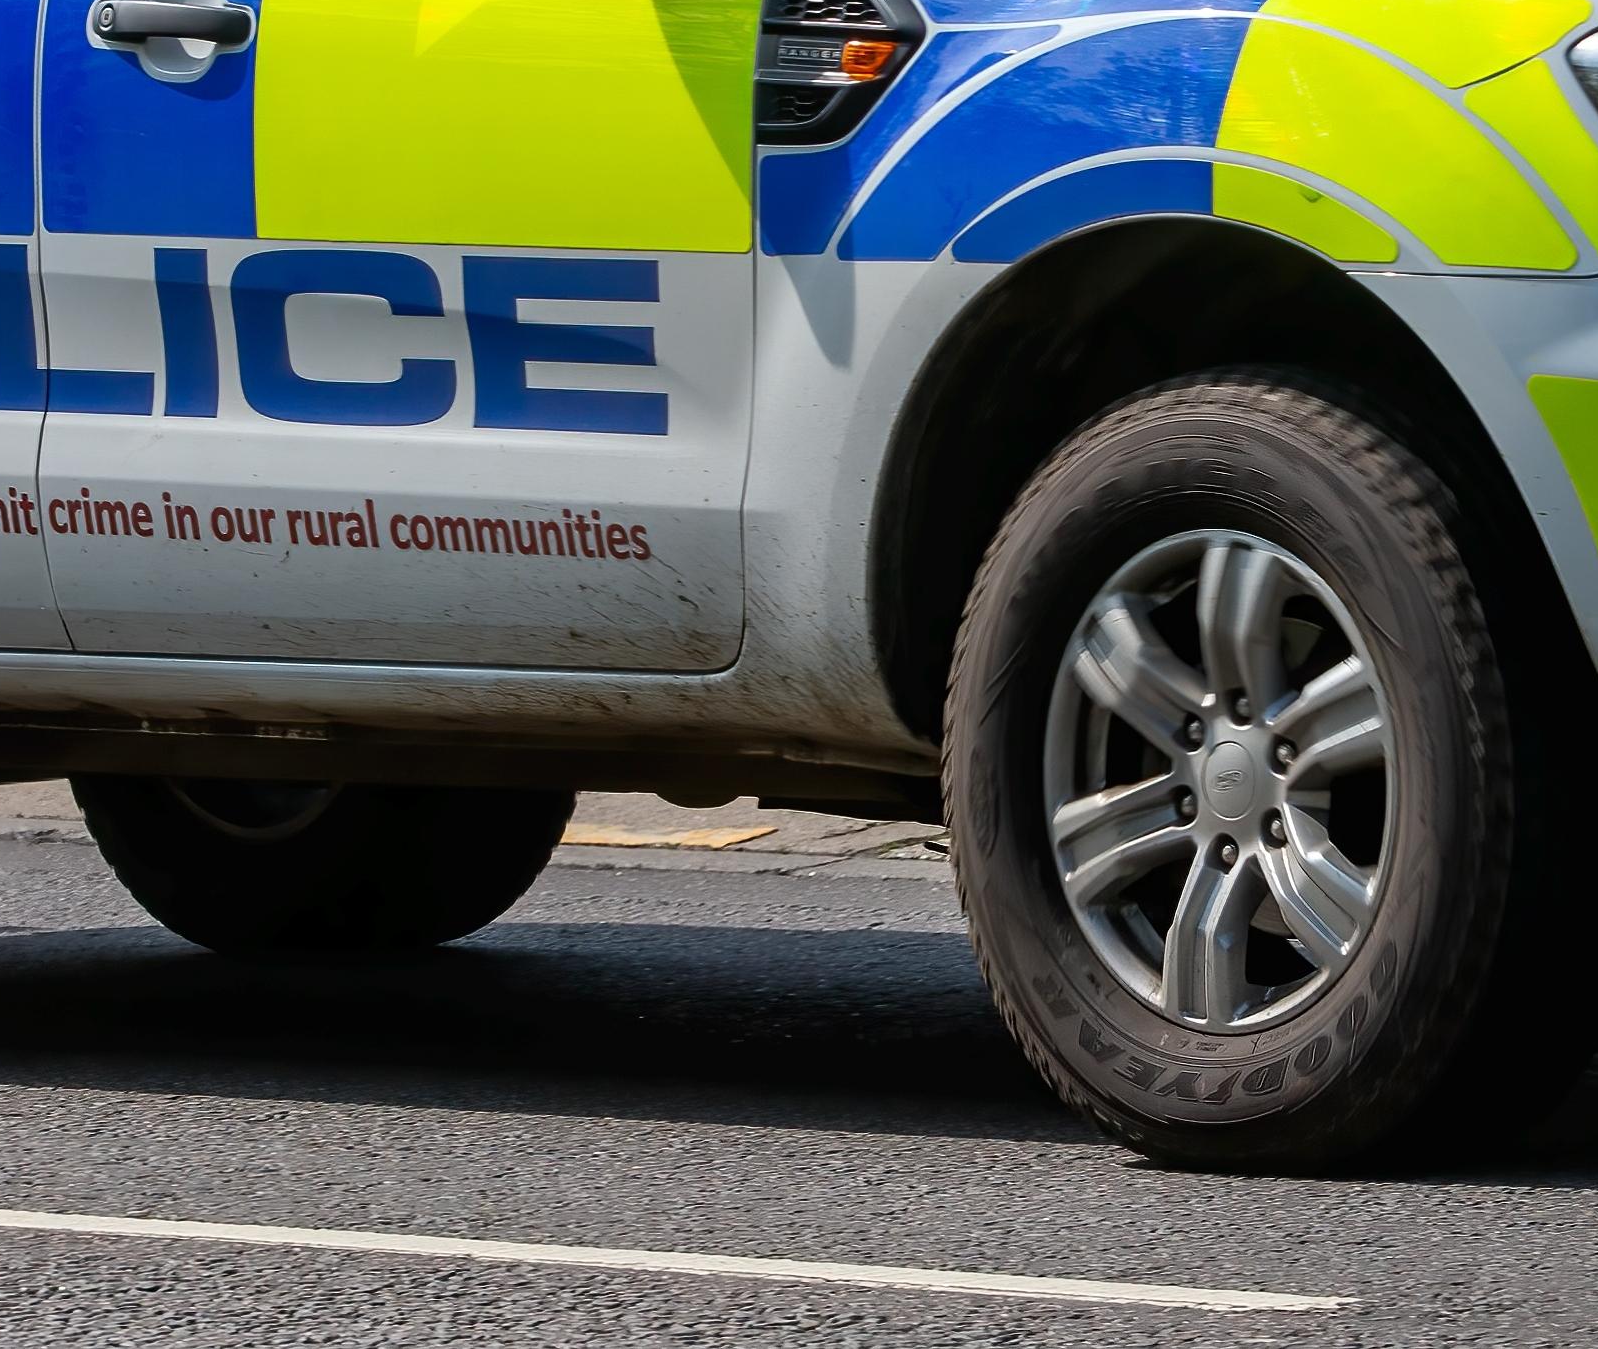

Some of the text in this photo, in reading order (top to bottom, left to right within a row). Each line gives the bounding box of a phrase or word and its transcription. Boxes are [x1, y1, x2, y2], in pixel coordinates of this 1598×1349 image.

[779, 48, 842, 58] RANGER
[48, 486, 154, 538] crime
[161, 490, 202, 541] in
[209, 504, 277, 544] our
[286, 498, 381, 549] rural
[389, 507, 653, 561] communities
